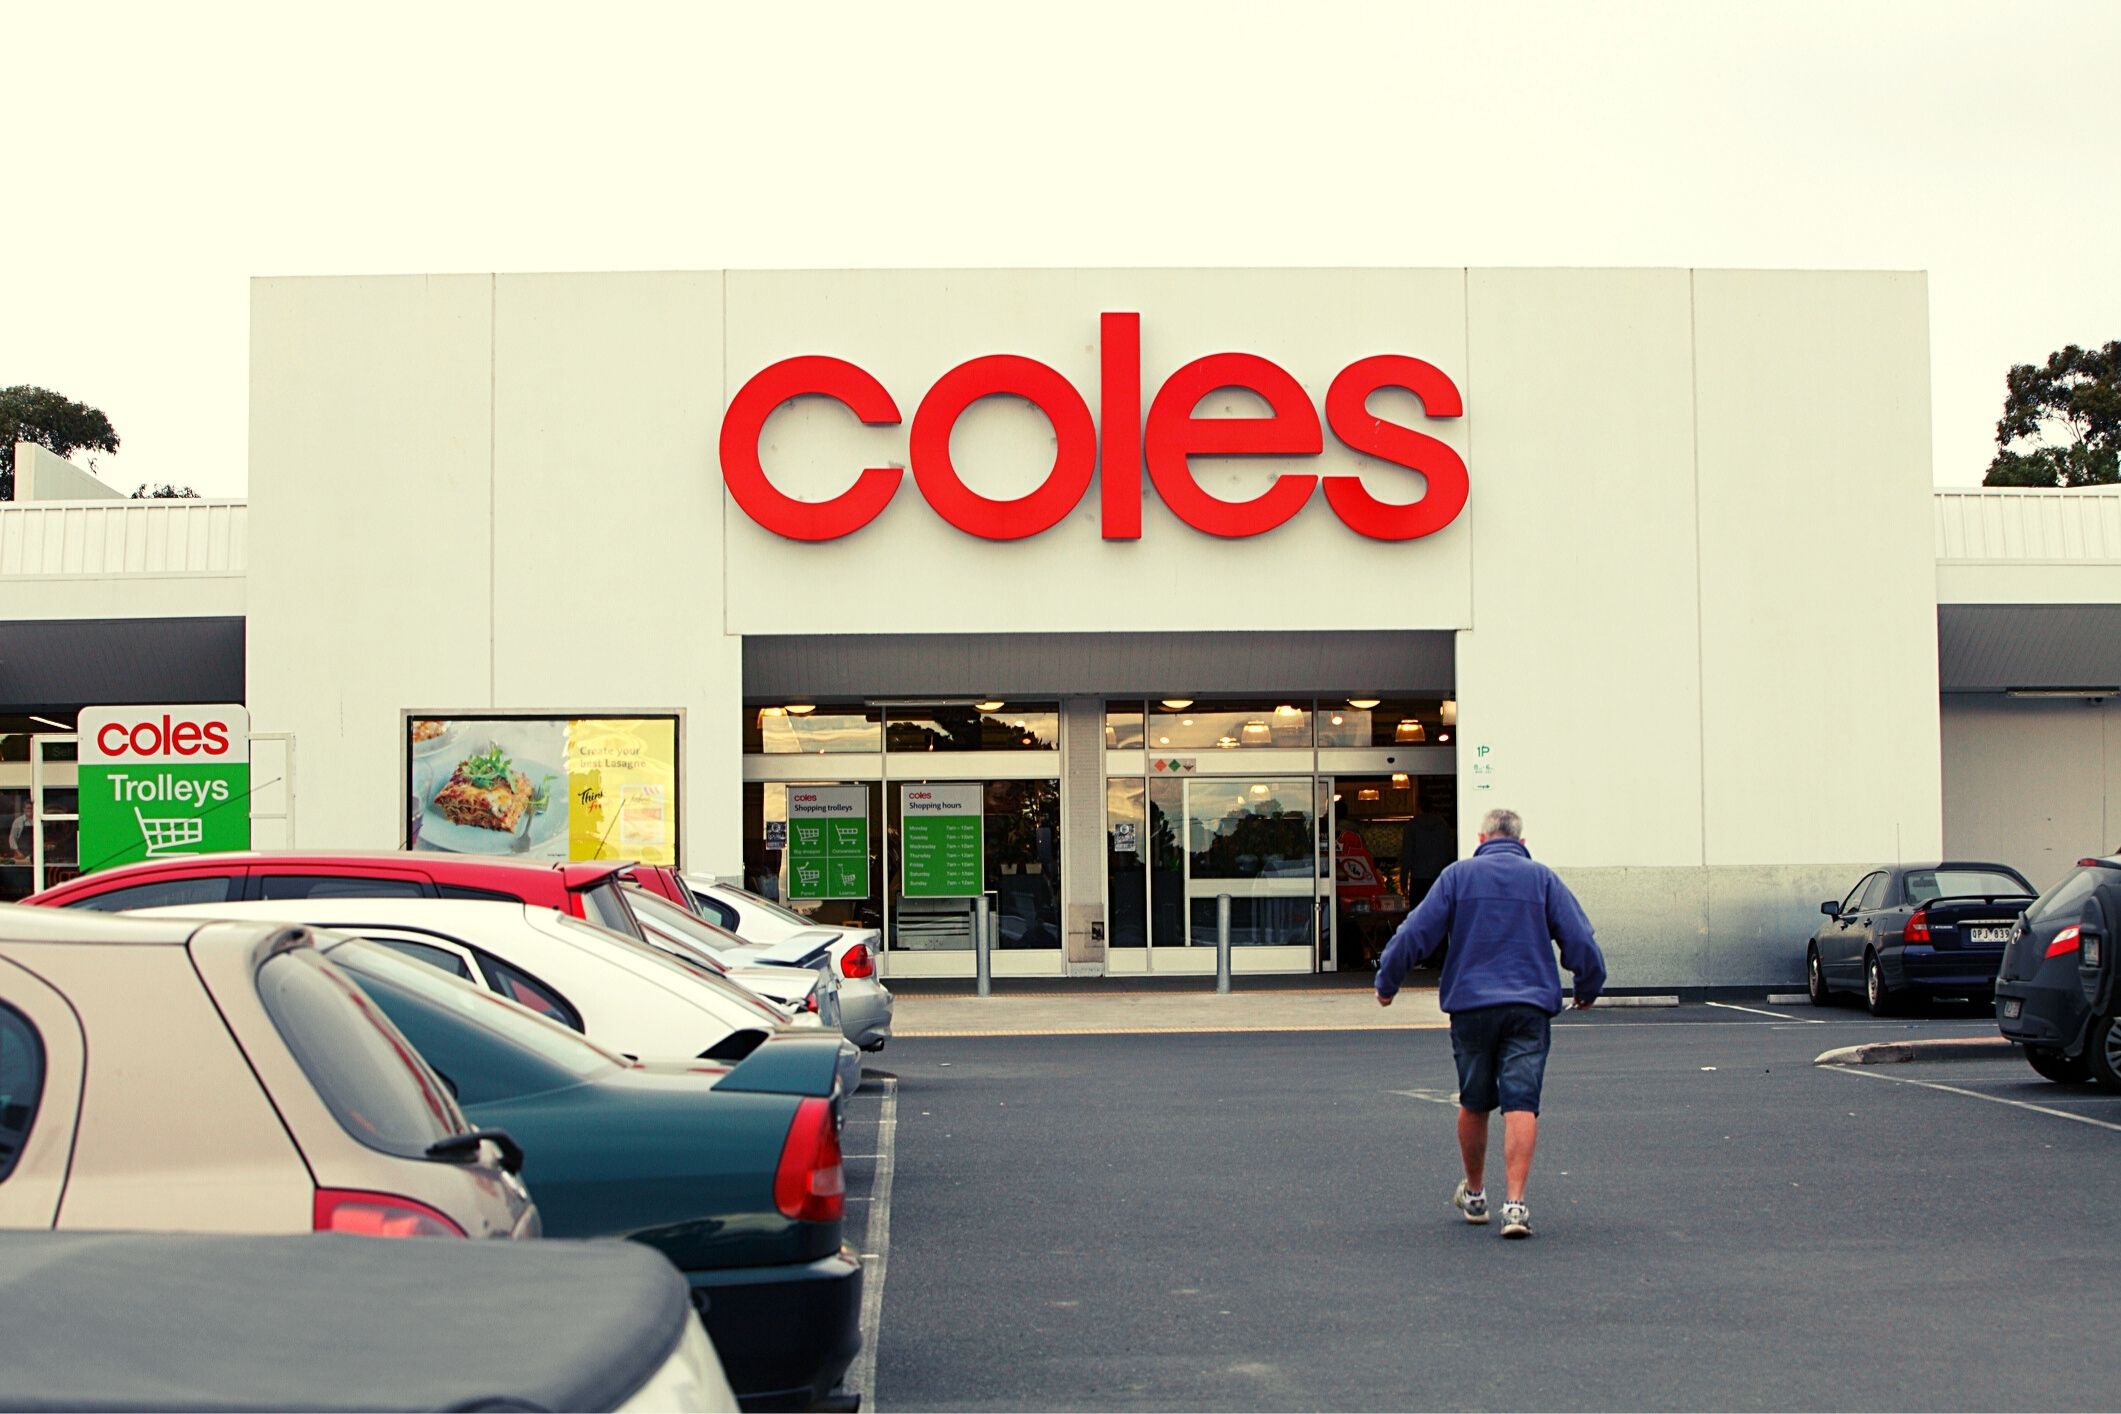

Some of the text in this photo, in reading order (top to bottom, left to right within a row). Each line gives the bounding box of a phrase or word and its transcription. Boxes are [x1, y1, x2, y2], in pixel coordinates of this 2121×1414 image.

[719, 312, 1470, 541] coles
[97, 714, 229, 756] coles
[617, 748, 641, 757] your
[605, 759, 646, 770] Lasagne
[107, 774, 229, 807] Trolleys
[794, 794, 817, 802] coles
[909, 792, 932, 800] coles
[794, 804, 853, 813] Shopping trolleys
[909, 802, 941, 811] Shopping
